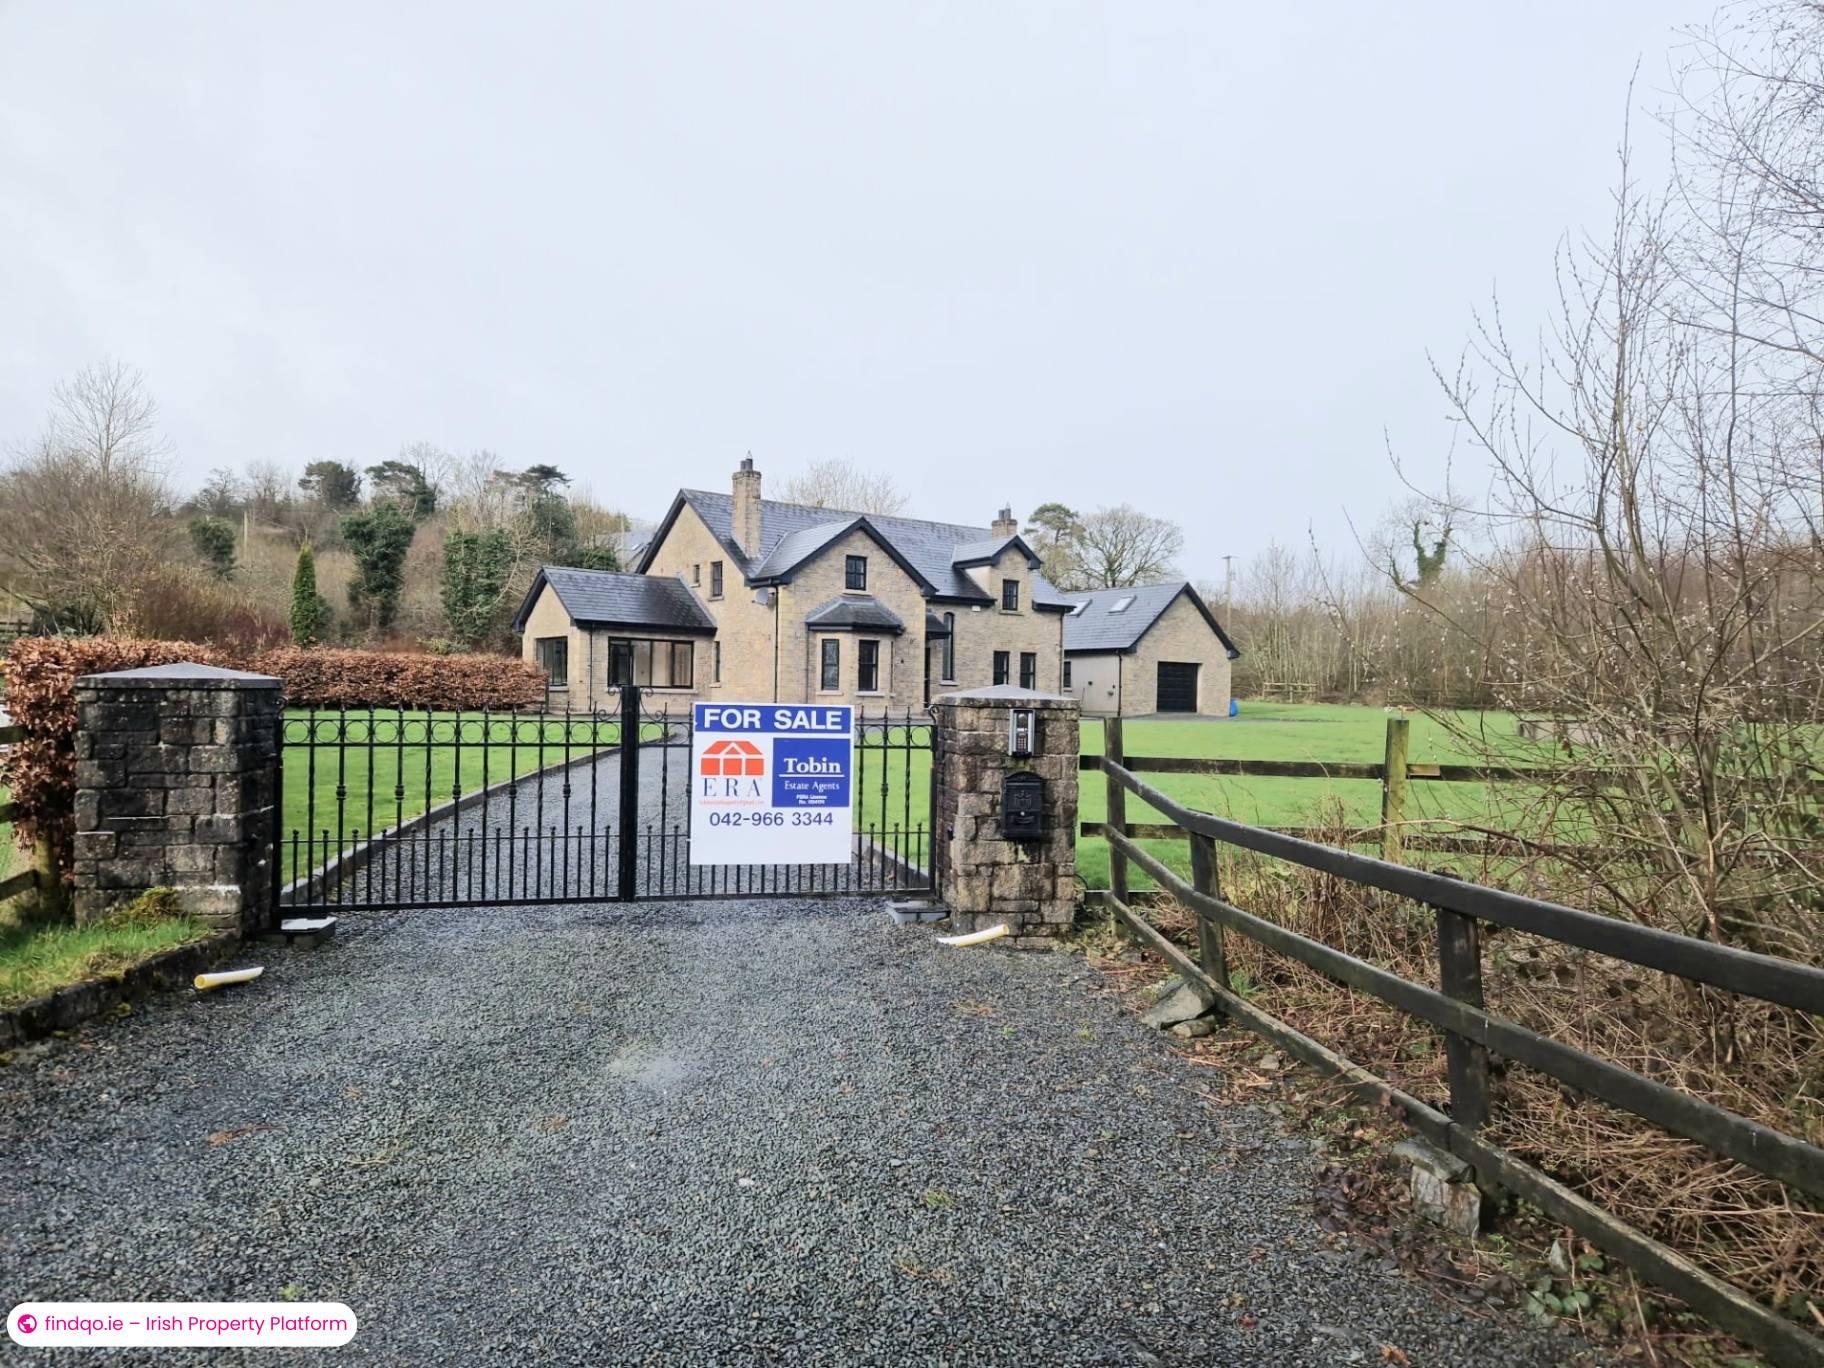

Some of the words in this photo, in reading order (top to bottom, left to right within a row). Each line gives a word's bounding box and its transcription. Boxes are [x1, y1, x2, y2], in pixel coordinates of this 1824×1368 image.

[704, 708, 761, 729] FOR
[774, 709, 842, 730] SALE
[784, 757, 841, 773] Tobin
[703, 777, 761, 797] ERA
[784, 781, 809, 790] Estate
[812, 780, 840, 793] Agents
[709, 812, 784, 826] 042-966
[792, 812, 833, 826] 3344
